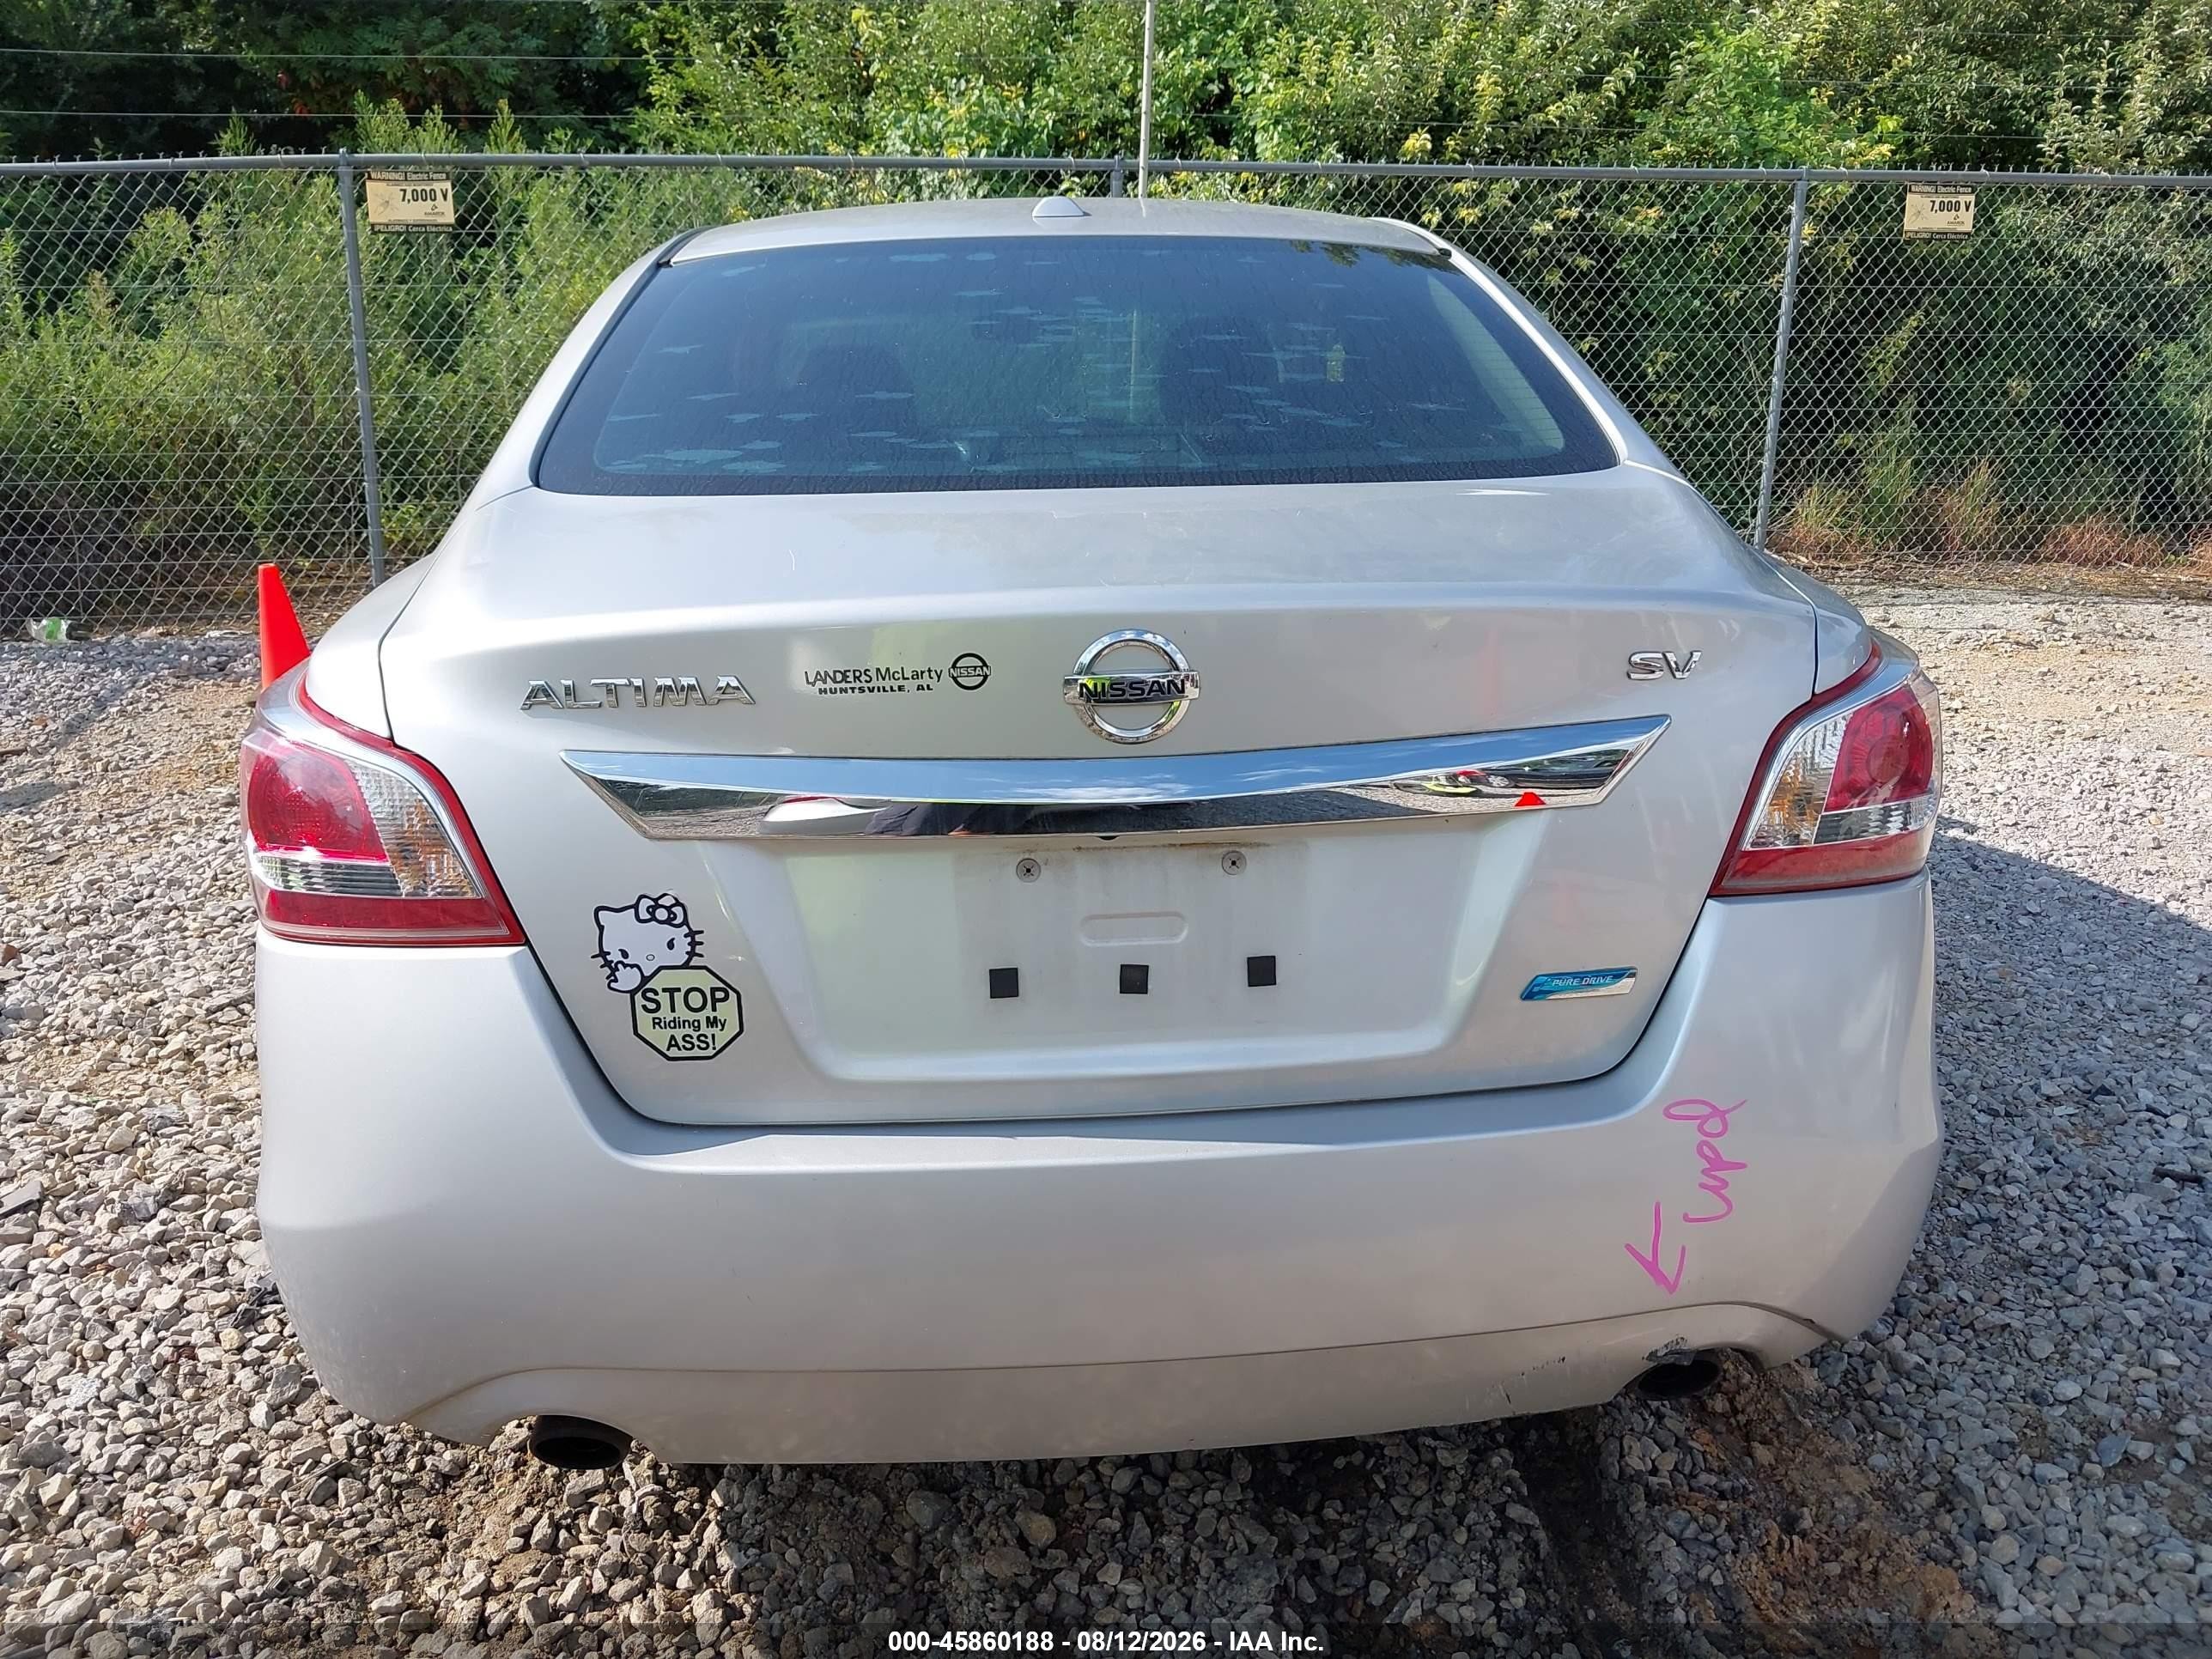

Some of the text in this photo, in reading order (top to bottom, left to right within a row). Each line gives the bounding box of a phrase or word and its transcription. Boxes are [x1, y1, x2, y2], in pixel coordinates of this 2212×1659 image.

[370, 171, 405, 180] WARNING!
[399, 188, 448, 204] 7,000 V
[1911, 185, 1936, 193] WARNING!
[1929, 200, 1972, 214] 7,000 V
[949, 665, 991, 678] NISSAN
[1626, 650, 1703, 680] SV
[805, 666, 944, 686] LANDERS McLarty
[520, 675, 757, 711] ALTIMA
[818, 684, 910, 696] HUNTSVILLE,
[1079, 678, 1187, 701] NISSAN
[1552, 975, 1614, 987] PURE DRIVE
[641, 987, 730, 1013] STOP
[652, 1016, 727, 1032] Riding My
[665, 1033, 717, 1051] ASS!
